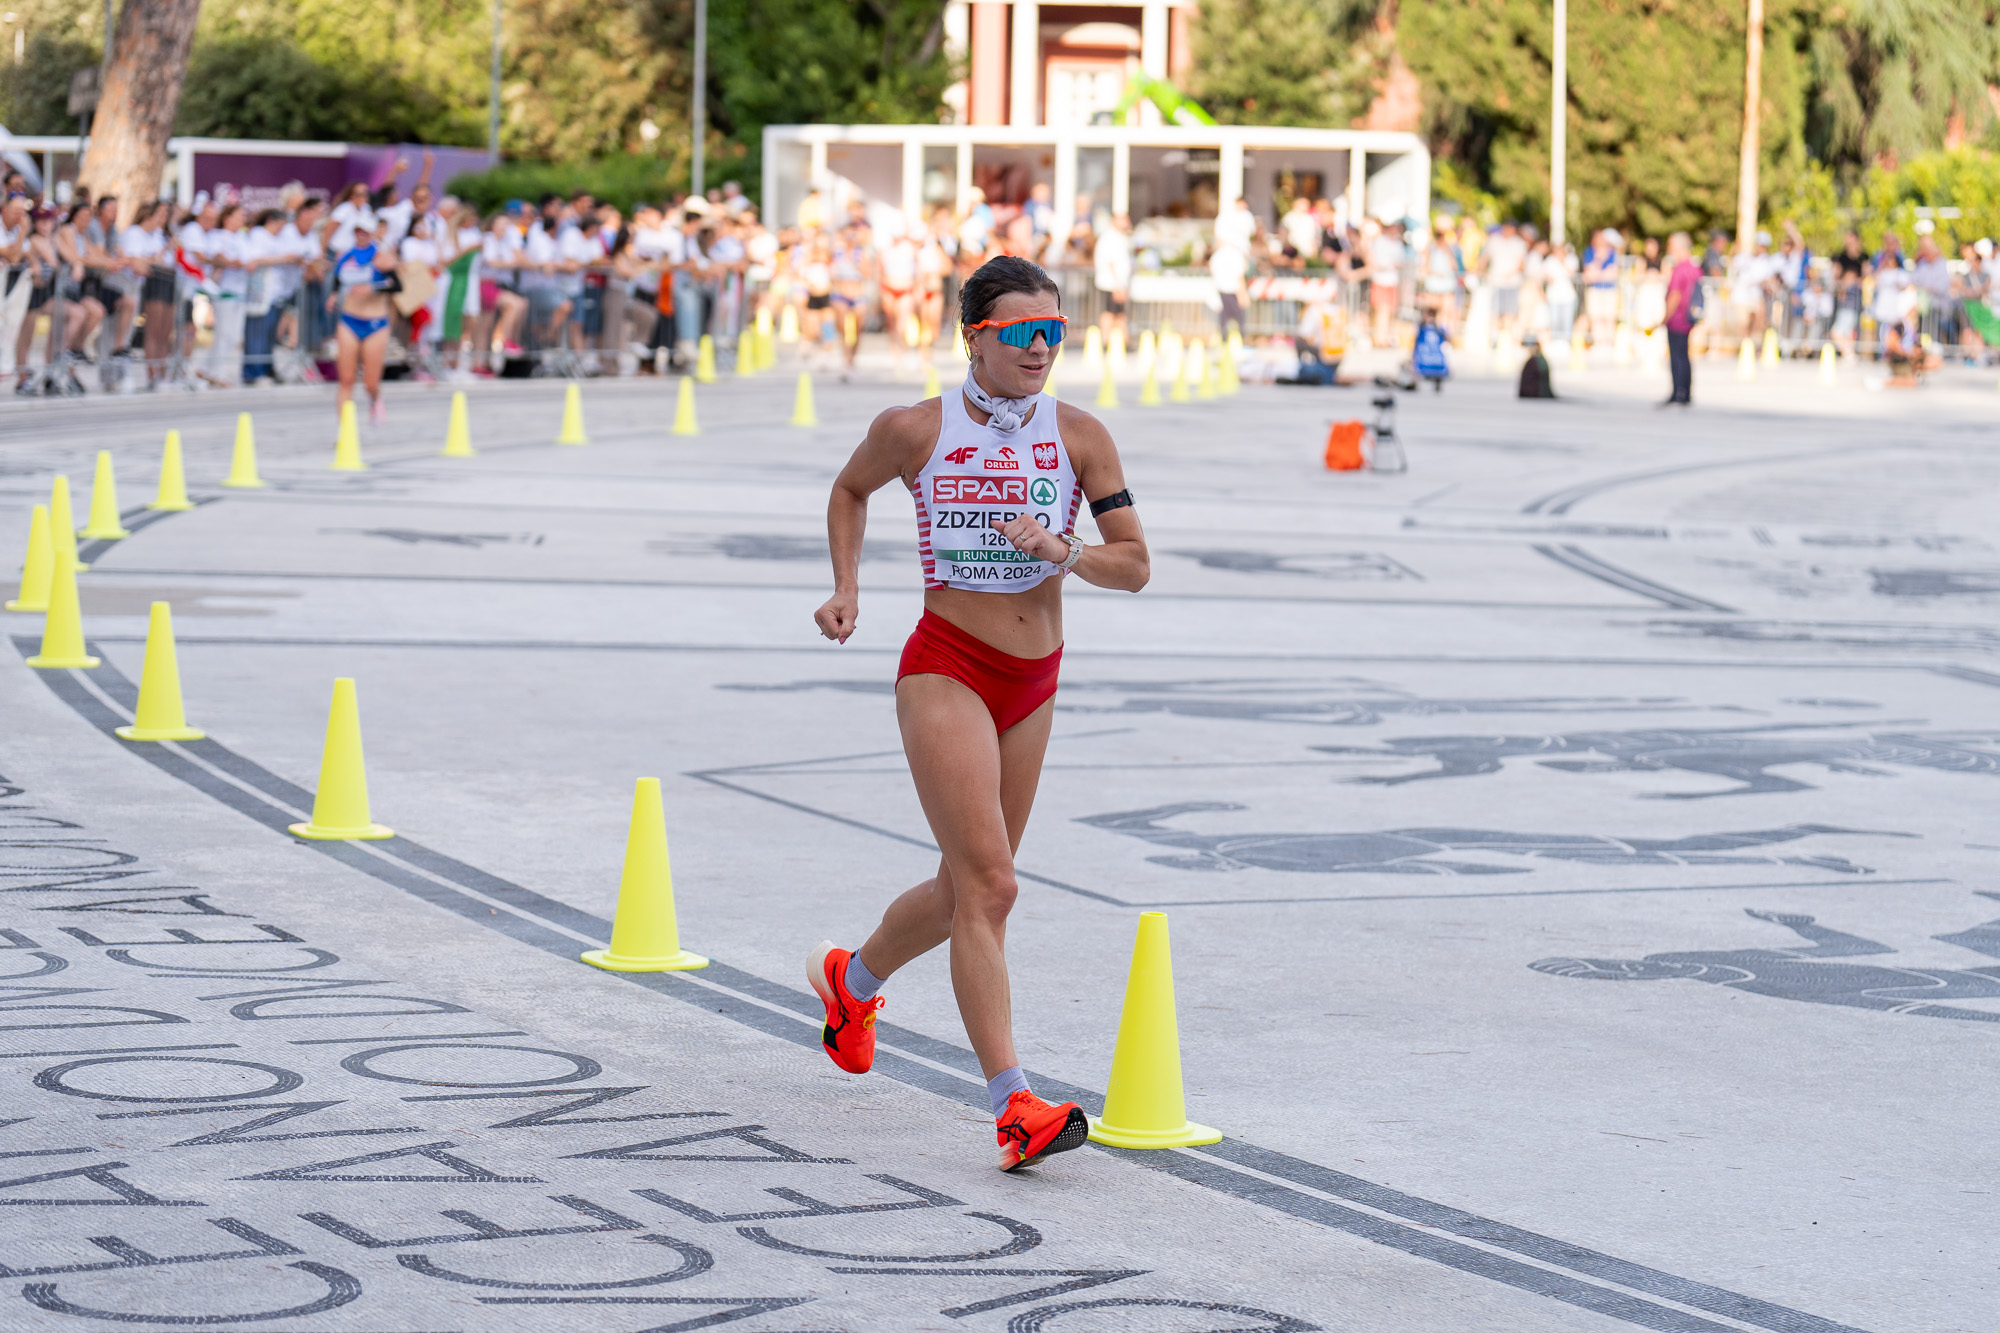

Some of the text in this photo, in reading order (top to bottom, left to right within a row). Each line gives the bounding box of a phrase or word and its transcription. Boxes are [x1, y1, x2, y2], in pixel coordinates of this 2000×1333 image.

[944, 447, 979, 464] 4F
[985, 461, 1017, 469] ORLEN
[936, 479, 1025, 500] SPAR
[936, 511, 1051, 529] ZDZIEBO
[979, 533, 1007, 546] 126
[957, 551, 1030, 561] I RUN CLEAN
[952, 564, 1041, 579] ROMA 2024
